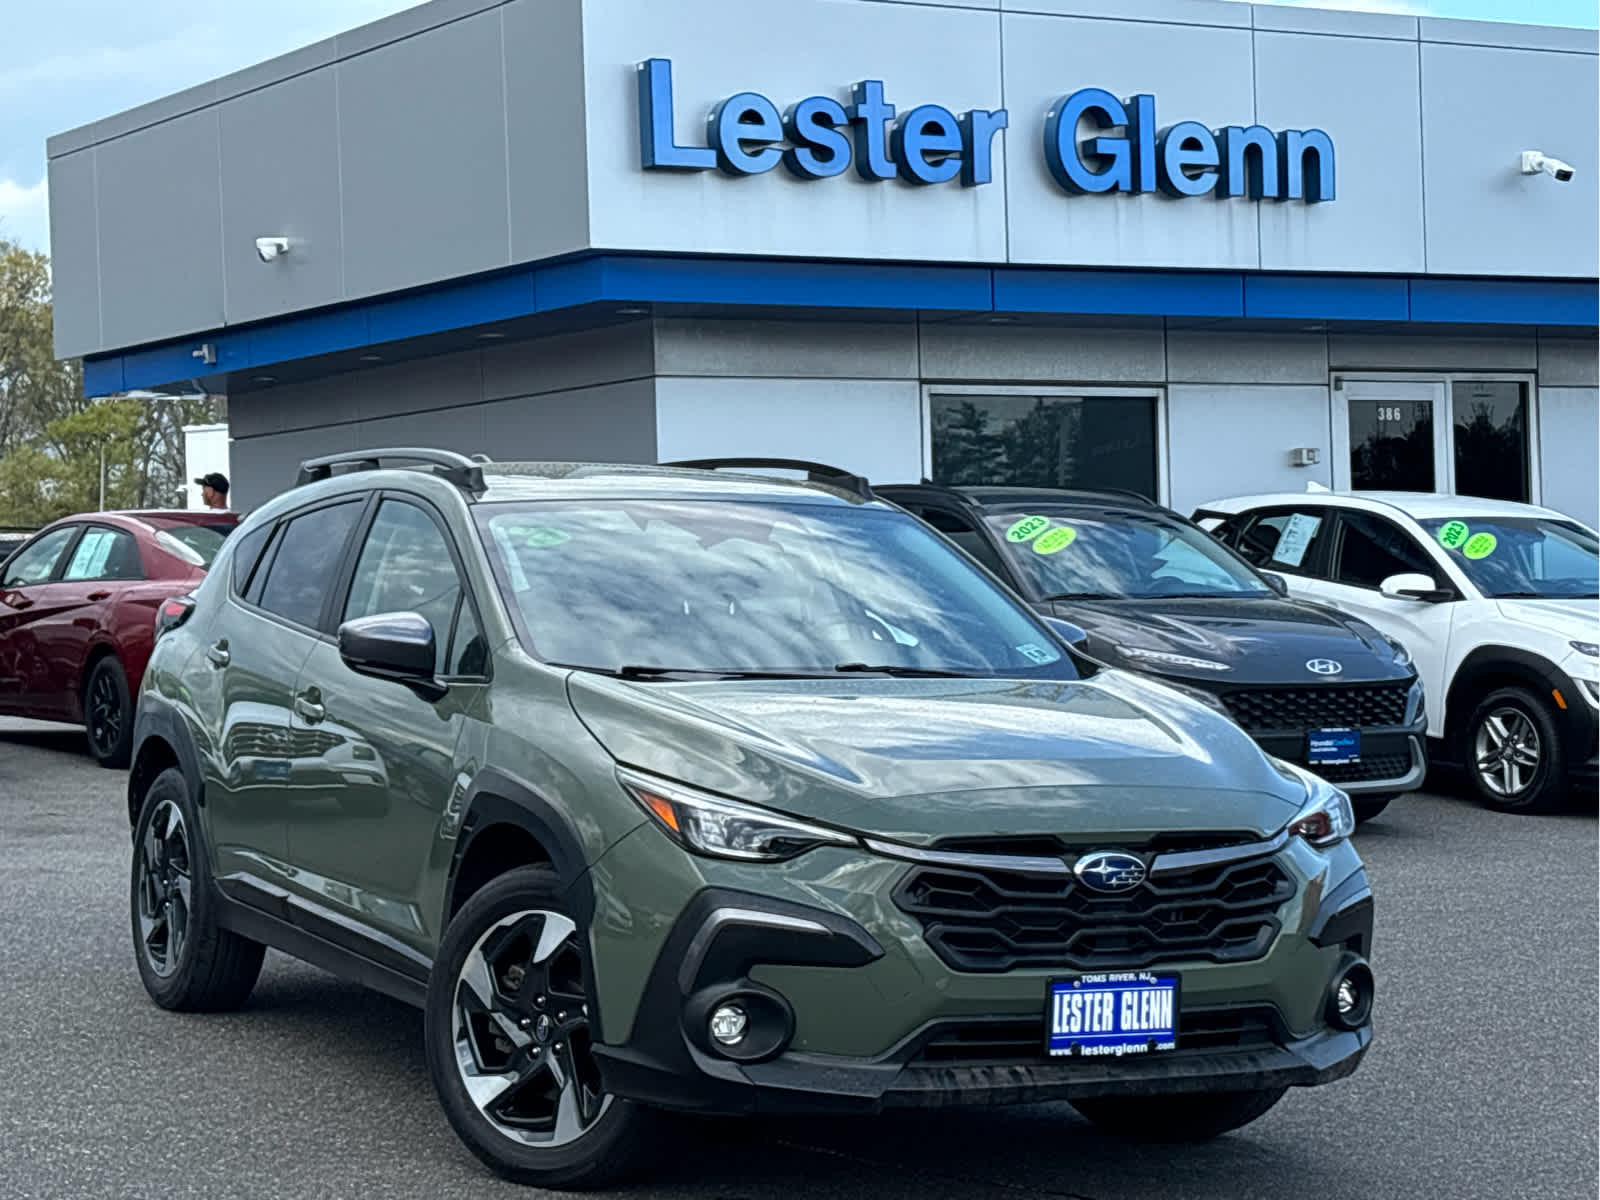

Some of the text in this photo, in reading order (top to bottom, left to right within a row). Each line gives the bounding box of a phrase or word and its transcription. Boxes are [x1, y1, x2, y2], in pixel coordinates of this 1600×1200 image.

[637, 58, 1336, 201] Lester Glenn
[1378, 407, 1401, 421] 386
[1011, 517, 1046, 540] 2023
[1443, 522, 1465, 546] 2023
[1081, 974, 1107, 984] TOMS
[1139, 971, 1151, 981] NJ
[1052, 989, 1173, 1034] LESTER GLENN
